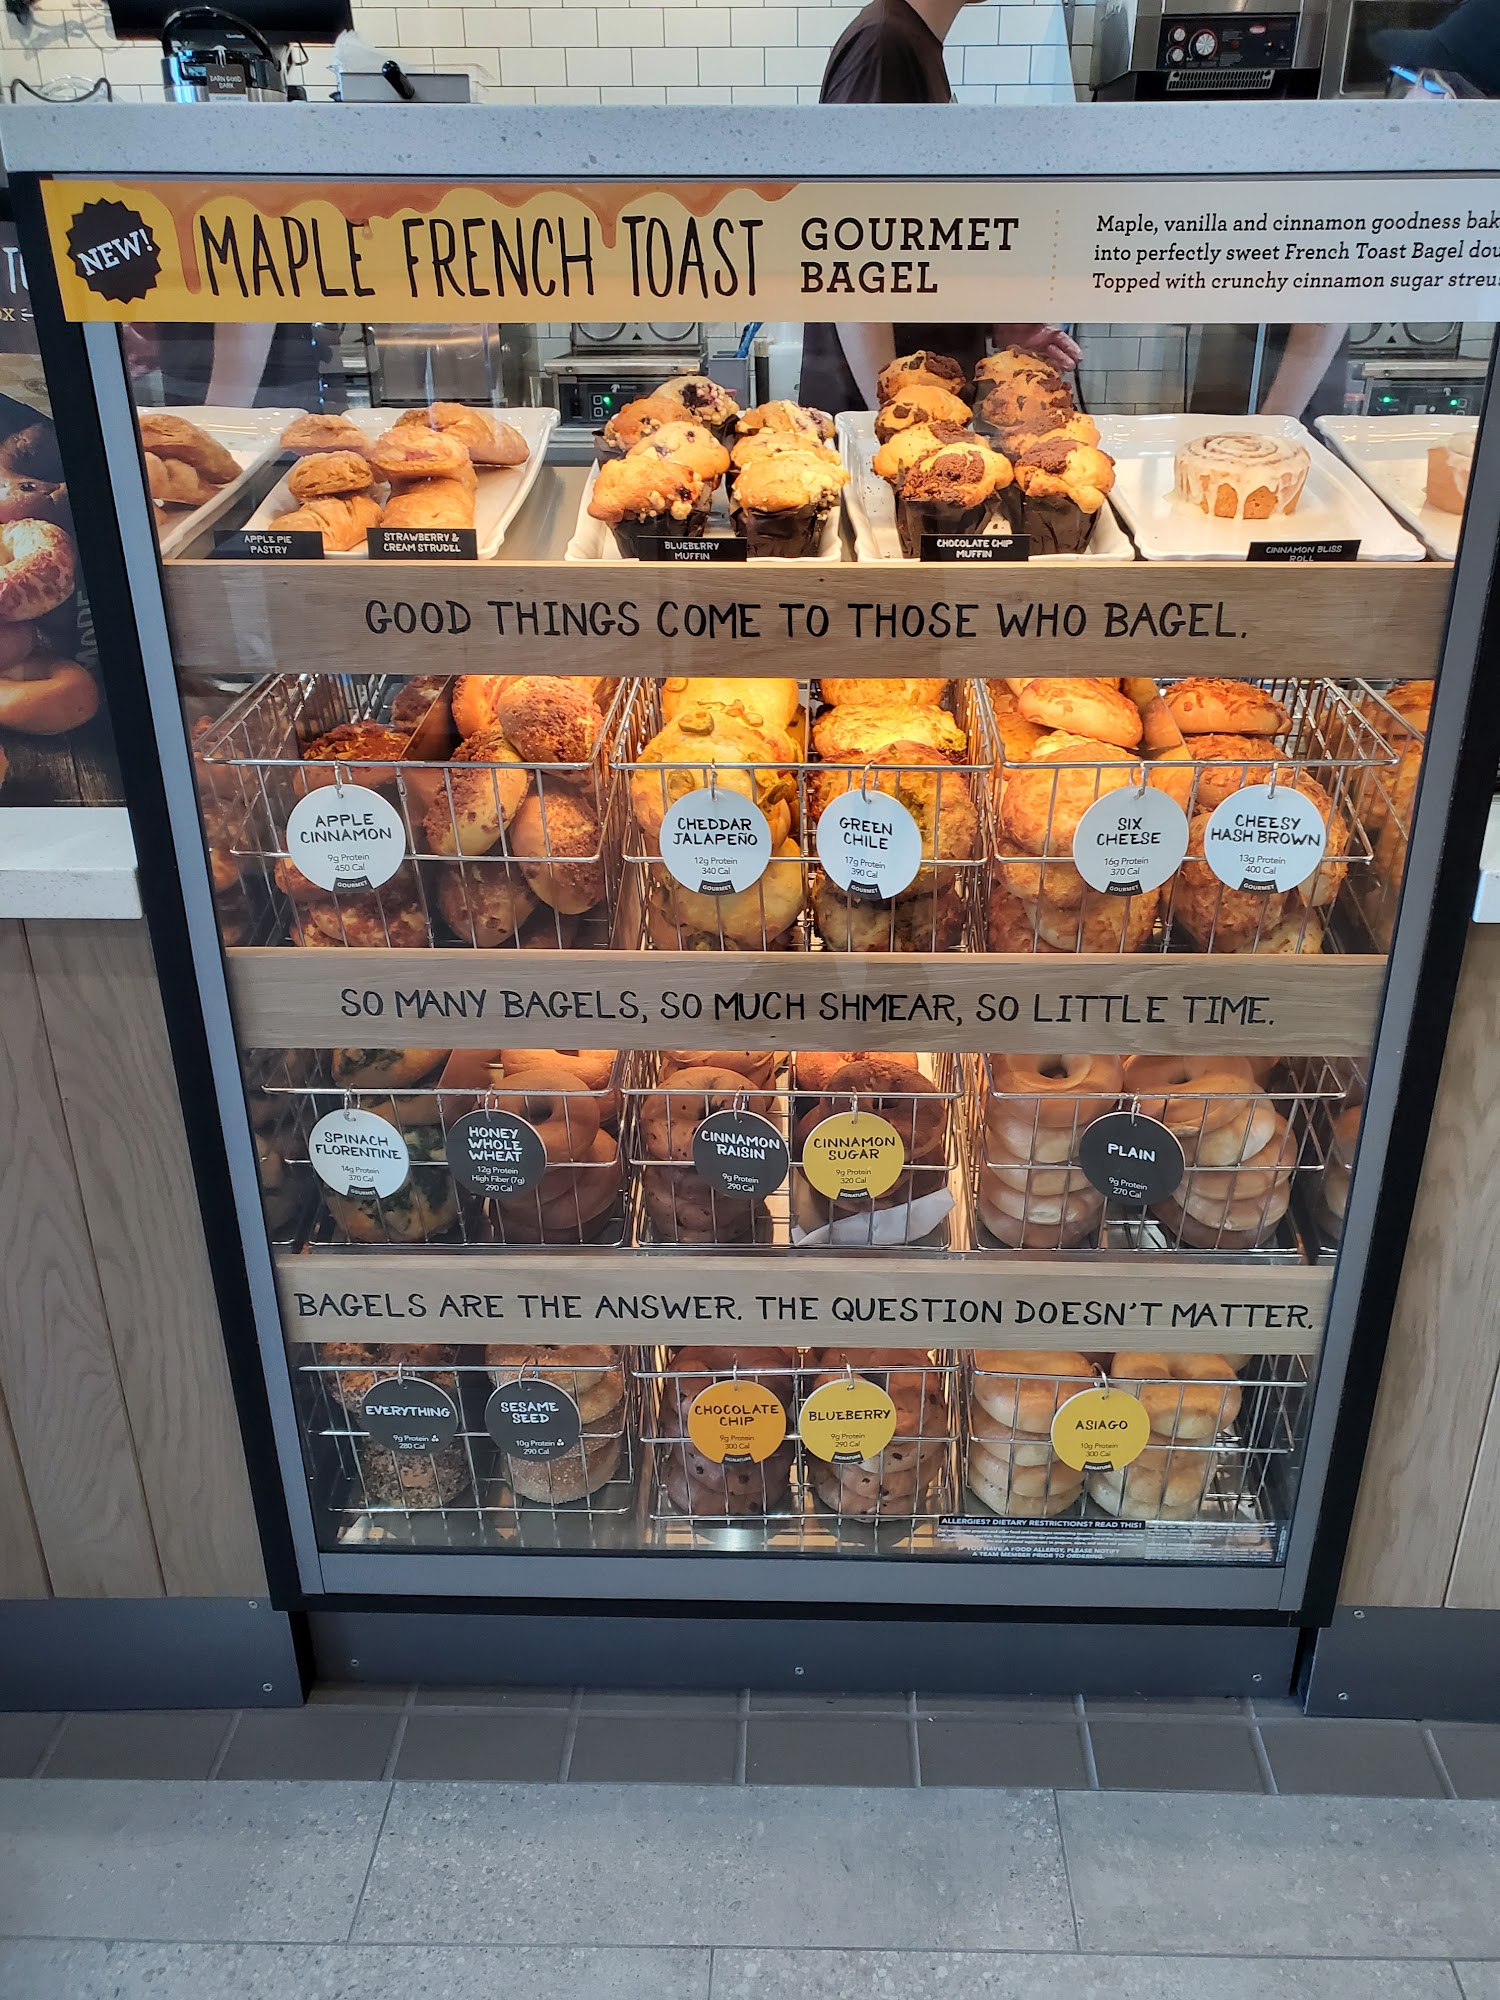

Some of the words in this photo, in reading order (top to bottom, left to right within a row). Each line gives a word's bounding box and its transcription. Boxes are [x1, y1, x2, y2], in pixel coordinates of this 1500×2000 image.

[1096, 214, 1158, 236] Maple,
[1164, 213, 1227, 233] vanilla
[1233, 213, 1268, 232] and
[1272, 213, 1366, 232] cinnamon
[1370, 210, 1461, 237] goodness
[801, 217, 1019, 251] GOURMET
[77, 228, 153, 276] NEW!
[200, 215, 376, 298] MAPLE
[402, 217, 595, 298] FRENCH
[622, 215, 764, 298] TOAST
[1094, 244, 1131, 262] into
[1136, 242, 1222, 266] perfectly
[1226, 245, 1280, 262] sweet
[1284, 242, 1350, 261] French
[1356, 242, 1407, 260] Toast
[1411, 240, 1464, 262] Bagel
[801, 261, 938, 294] BAGEL
[1093, 272, 1160, 293] Topped
[1165, 271, 1206, 289] with
[1211, 271, 1287, 293] crunchy
[1292, 272, 1385, 289] cinnamon
[1390, 275, 1444, 291] sugar
[244, 535, 276, 544] APPLE
[277, 535, 292, 544] PIE
[383, 532, 450, 542] STRAWBERRY
[451, 533, 459, 542] &
[383, 543, 416, 552] CREAM
[417, 544, 461, 553] STRUDEL
[664, 541, 719, 550] BLUEBERRY
[936, 539, 989, 548] CHOCOLATE
[991, 539, 1013, 548] CHIP
[1265, 546, 1315, 554] CINNAMON
[1317, 545, 1342, 553] BLISS
[250, 545, 288, 555] PASTRY
[674, 552, 710, 560] MUFFIN
[956, 550, 993, 559] MUFFIN
[365, 600, 471, 634] GOOD
[487, 600, 640, 636] THINGS
[657, 601, 761, 638] COME
[778, 603, 830, 637] TO
[847, 602, 979, 638] THOSE
[996, 602, 1086, 637] WHO
[1104, 601, 1247, 639] BAGEL.
[315, 813, 375, 828] APPLE
[677, 817, 752, 831] CHEDDAR
[839, 816, 893, 836] GREEN
[1117, 817, 1143, 831] SIX
[1235, 814, 1302, 830] CHEESY
[300, 827, 392, 843] CINNAMON
[672, 832, 758, 845] JALAPEÑO
[843, 832, 889, 850] CHILE
[1096, 832, 1162, 846] CHEESE
[1211, 828, 1253, 842] HASH
[1257, 830, 1321, 847] BROWN
[327, 854, 340, 863] 9g
[341, 853, 370, 861] Protein
[694, 857, 709, 865] 12g
[711, 857, 738, 865] Protein
[845, 856, 859, 867] 17g
[860, 859, 886, 869] Protein
[1104, 857, 1120, 866] 16g
[1121, 857, 1149, 865] Protein
[1239, 854, 1255, 864] 13g
[1256, 856, 1286, 864] Protein
[334, 864, 350, 872] 450
[352, 863, 366, 871] Cal
[702, 867, 717, 875] 340
[718, 867, 731, 875] Cal
[851, 868, 865, 877] 390
[866, 870, 878, 878] Cal
[1110, 868, 1126, 876] 370
[1127, 867, 1140, 875] Cal
[1245, 865, 1261, 873] 400
[1262, 866, 1277, 874] Cal
[1243, 882, 1275, 891] GOURMET
[340, 988, 384, 1017] SO
[393, 989, 487, 1018] MANY
[499, 990, 648, 1023] BAGELS,
[659, 992, 701, 1020] SO
[714, 992, 805, 1020] MUCH
[818, 993, 963, 1026] SHMEAR,
[975, 993, 1019, 1021] SO
[1033, 993, 1166, 1023] LITTLE
[1183, 995, 1275, 1025] TIME.
[324, 1131, 389, 1146] SPINACH
[468, 1126, 518, 1139] HONEY
[467, 1138, 523, 1151] WHOLE
[701, 1130, 780, 1150] CINNAMON
[813, 1136, 896, 1148] CINNAMON
[315, 1144, 402, 1160] FLORENTINE
[468, 1150, 522, 1162] WHEAT
[716, 1143, 766, 1160] RAISIN
[828, 1148, 880, 1161] SUGAR
[1107, 1143, 1156, 1162] PLAIN
[341, 1165, 354, 1174] 14g
[477, 1166, 491, 1174] 12g
[835, 1169, 845, 1177] 9g
[471, 1174, 490, 1183] High
[511, 1176, 525, 1185] (7g)
[722, 1172, 732, 1183] 9g
[733, 1174, 759, 1184] Protein
[1108, 1176, 1119, 1187] 9g
[1120, 1179, 1148, 1190] Protein
[485, 1184, 499, 1192] 290
[727, 1183, 741, 1191] 290
[742, 1184, 755, 1192] Cal
[1112, 1187, 1128, 1196] 270
[1128, 1190, 1142, 1199] Cal
[294, 1292, 427, 1319] BAGELS
[439, 1294, 504, 1319] ARE
[517, 1294, 582, 1320] THE
[595, 1295, 743, 1321] ANSWER.
[755, 1296, 818, 1321] THE
[831, 1297, 1002, 1324] QUESTION
[1014, 1299, 1163, 1326] DOESN'T
[1171, 1301, 1314, 1330] MATTER.
[365, 1405, 451, 1418] EVERYTHING
[500, 1401, 560, 1413] SESAME
[694, 1404, 779, 1415] CHOCOLATE
[512, 1413, 550, 1424] SEED
[719, 1416, 755, 1426] CHIP
[808, 1409, 891, 1421] BLUEBERRY
[1075, 1419, 1128, 1430] ASIAGO
[516, 1440, 530, 1448] 10g
[941, 1517, 990, 1525] ALLERGIES?
